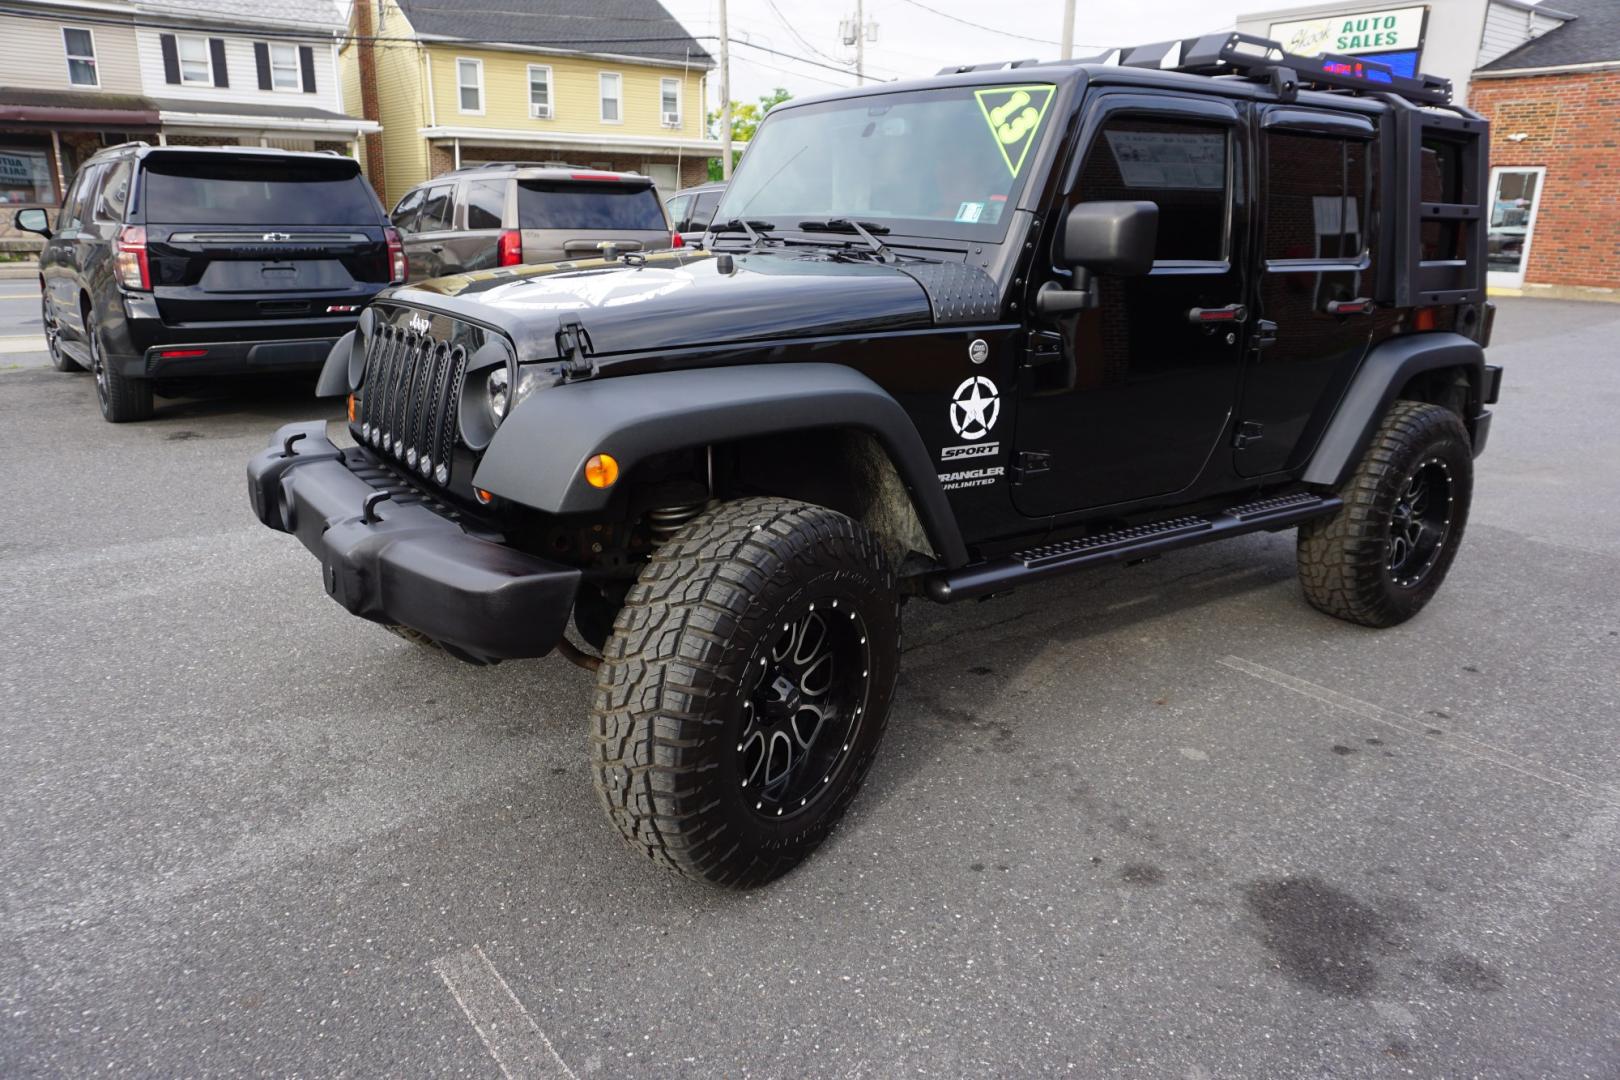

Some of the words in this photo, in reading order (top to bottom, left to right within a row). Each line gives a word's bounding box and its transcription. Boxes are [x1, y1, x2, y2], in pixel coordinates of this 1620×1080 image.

[1342, 16, 1396, 33] AUTO
[1337, 32, 1398, 49] SALES
[943, 444, 999, 460] SPORT
